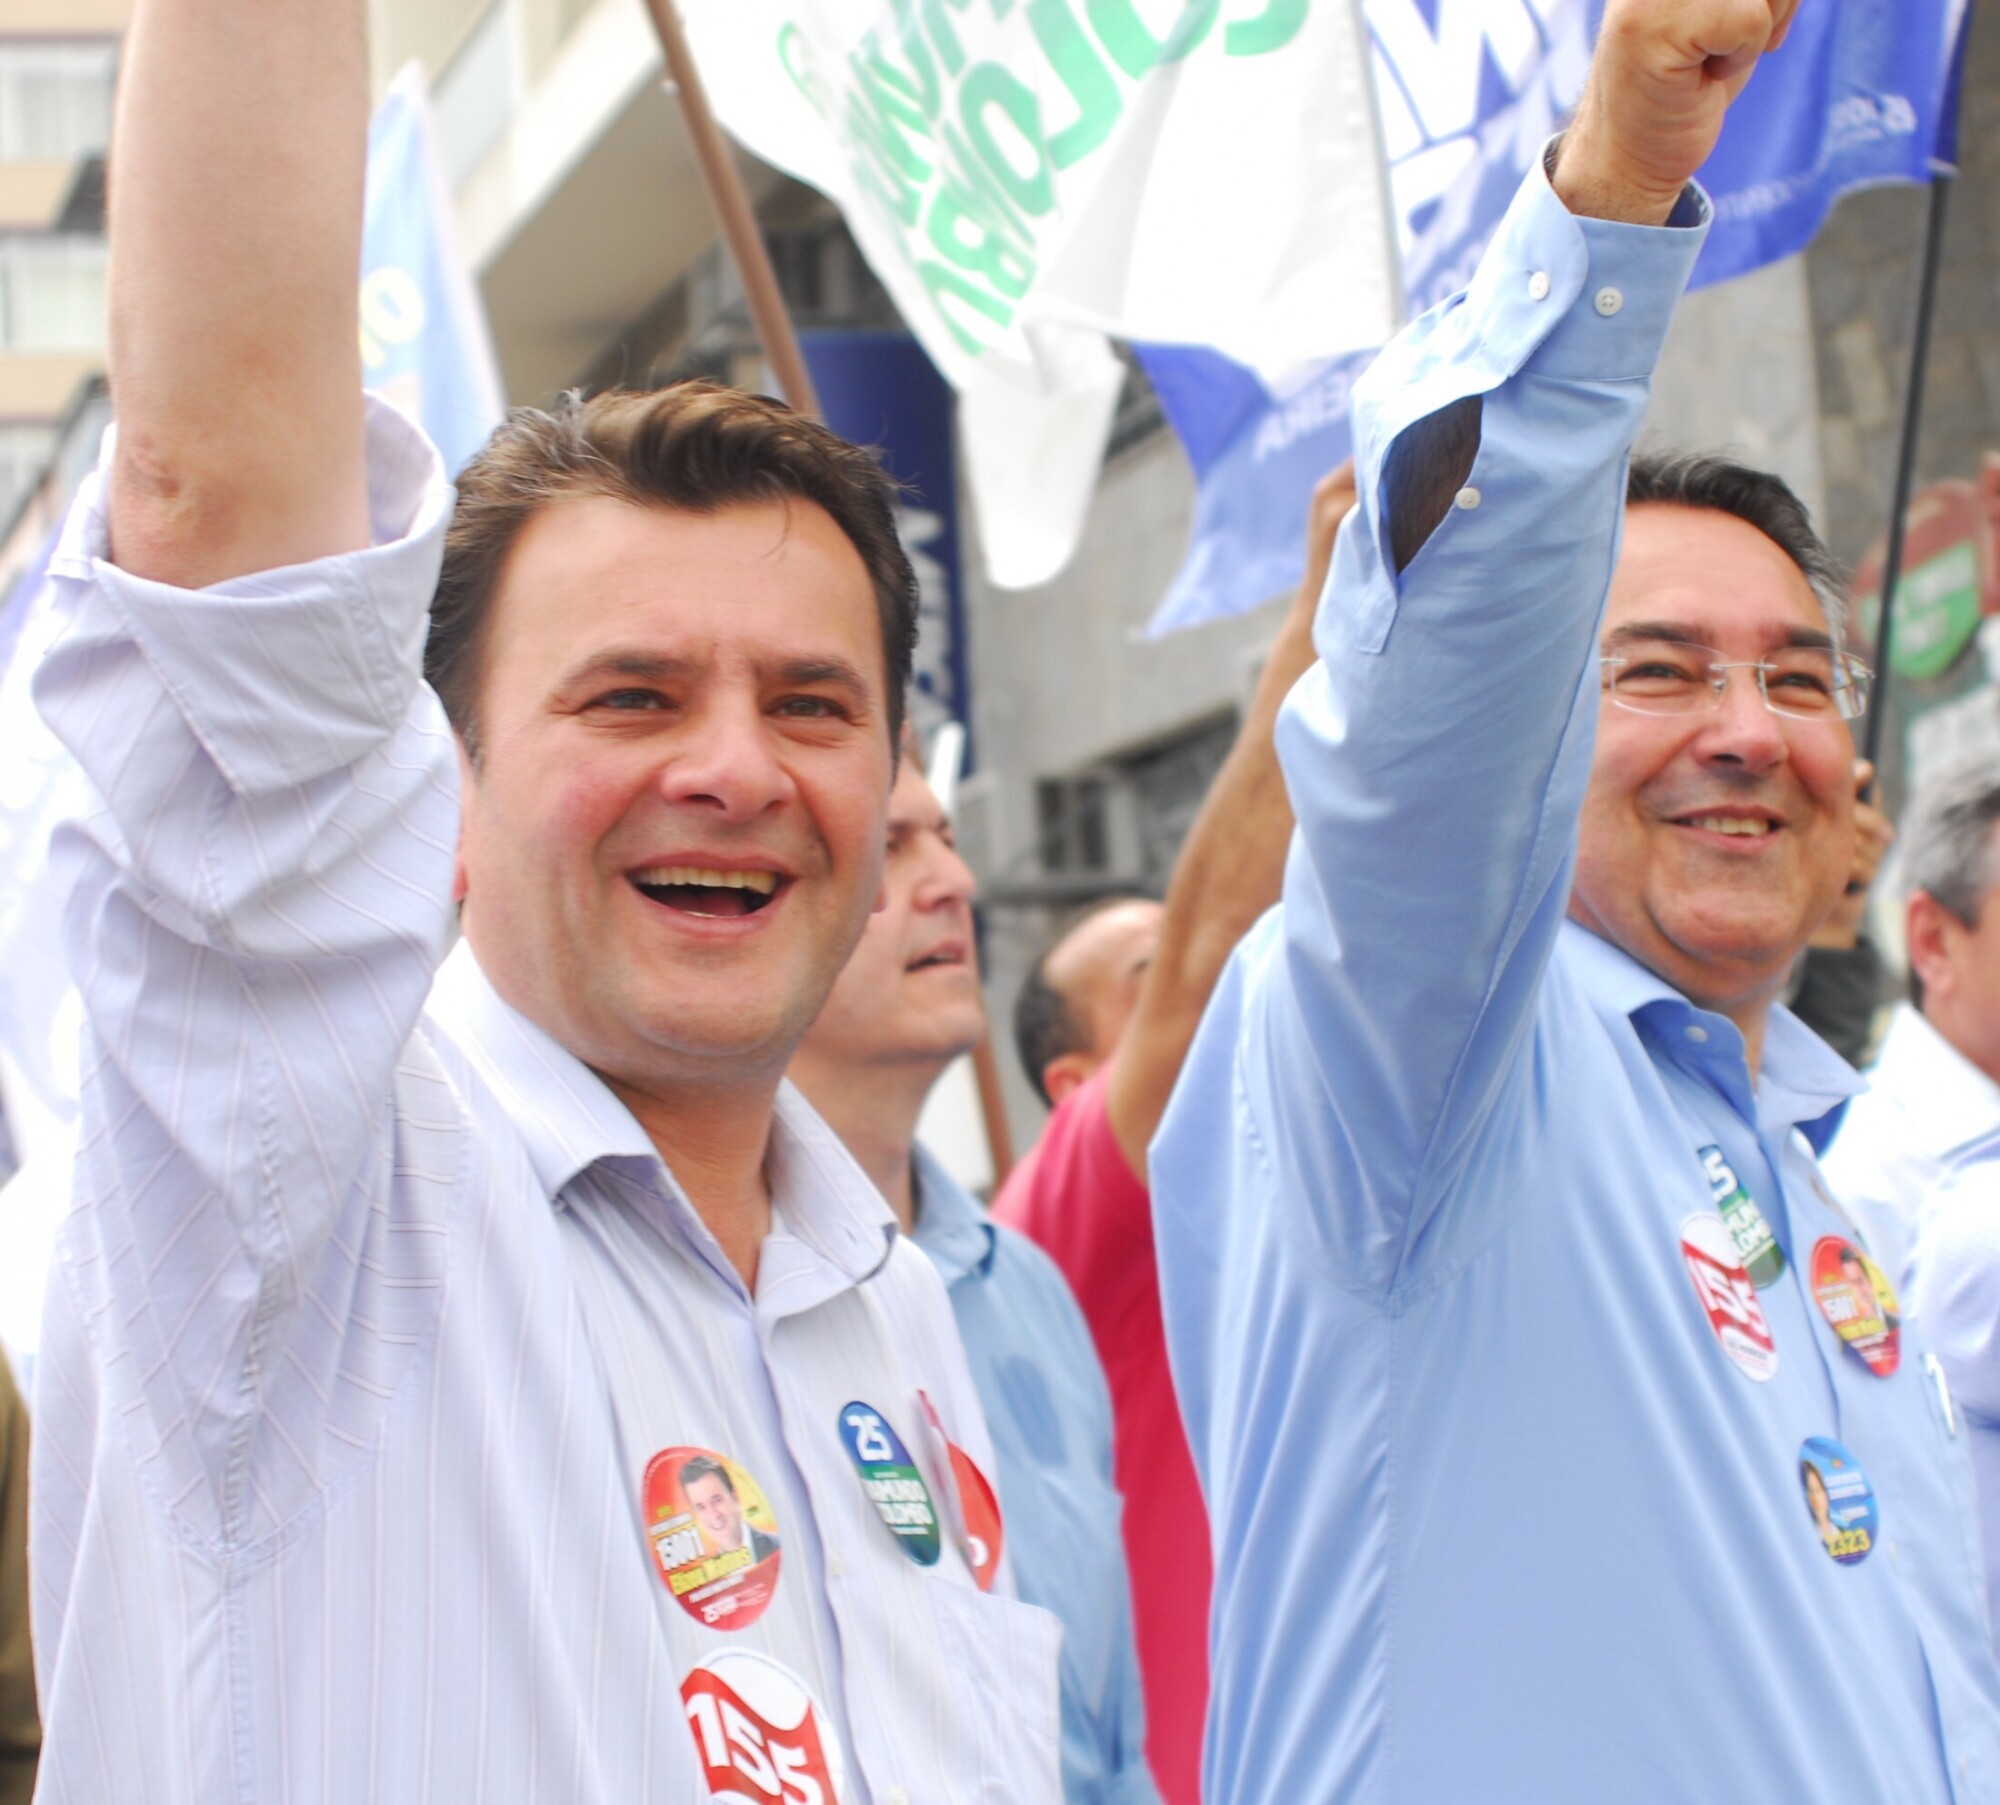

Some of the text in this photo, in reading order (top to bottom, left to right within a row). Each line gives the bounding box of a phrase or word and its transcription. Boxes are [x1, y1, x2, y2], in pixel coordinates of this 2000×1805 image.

[1703, 1151, 1739, 1202] 5
[846, 1414, 893, 1461] 25
[685, 1691, 825, 1805] 155
